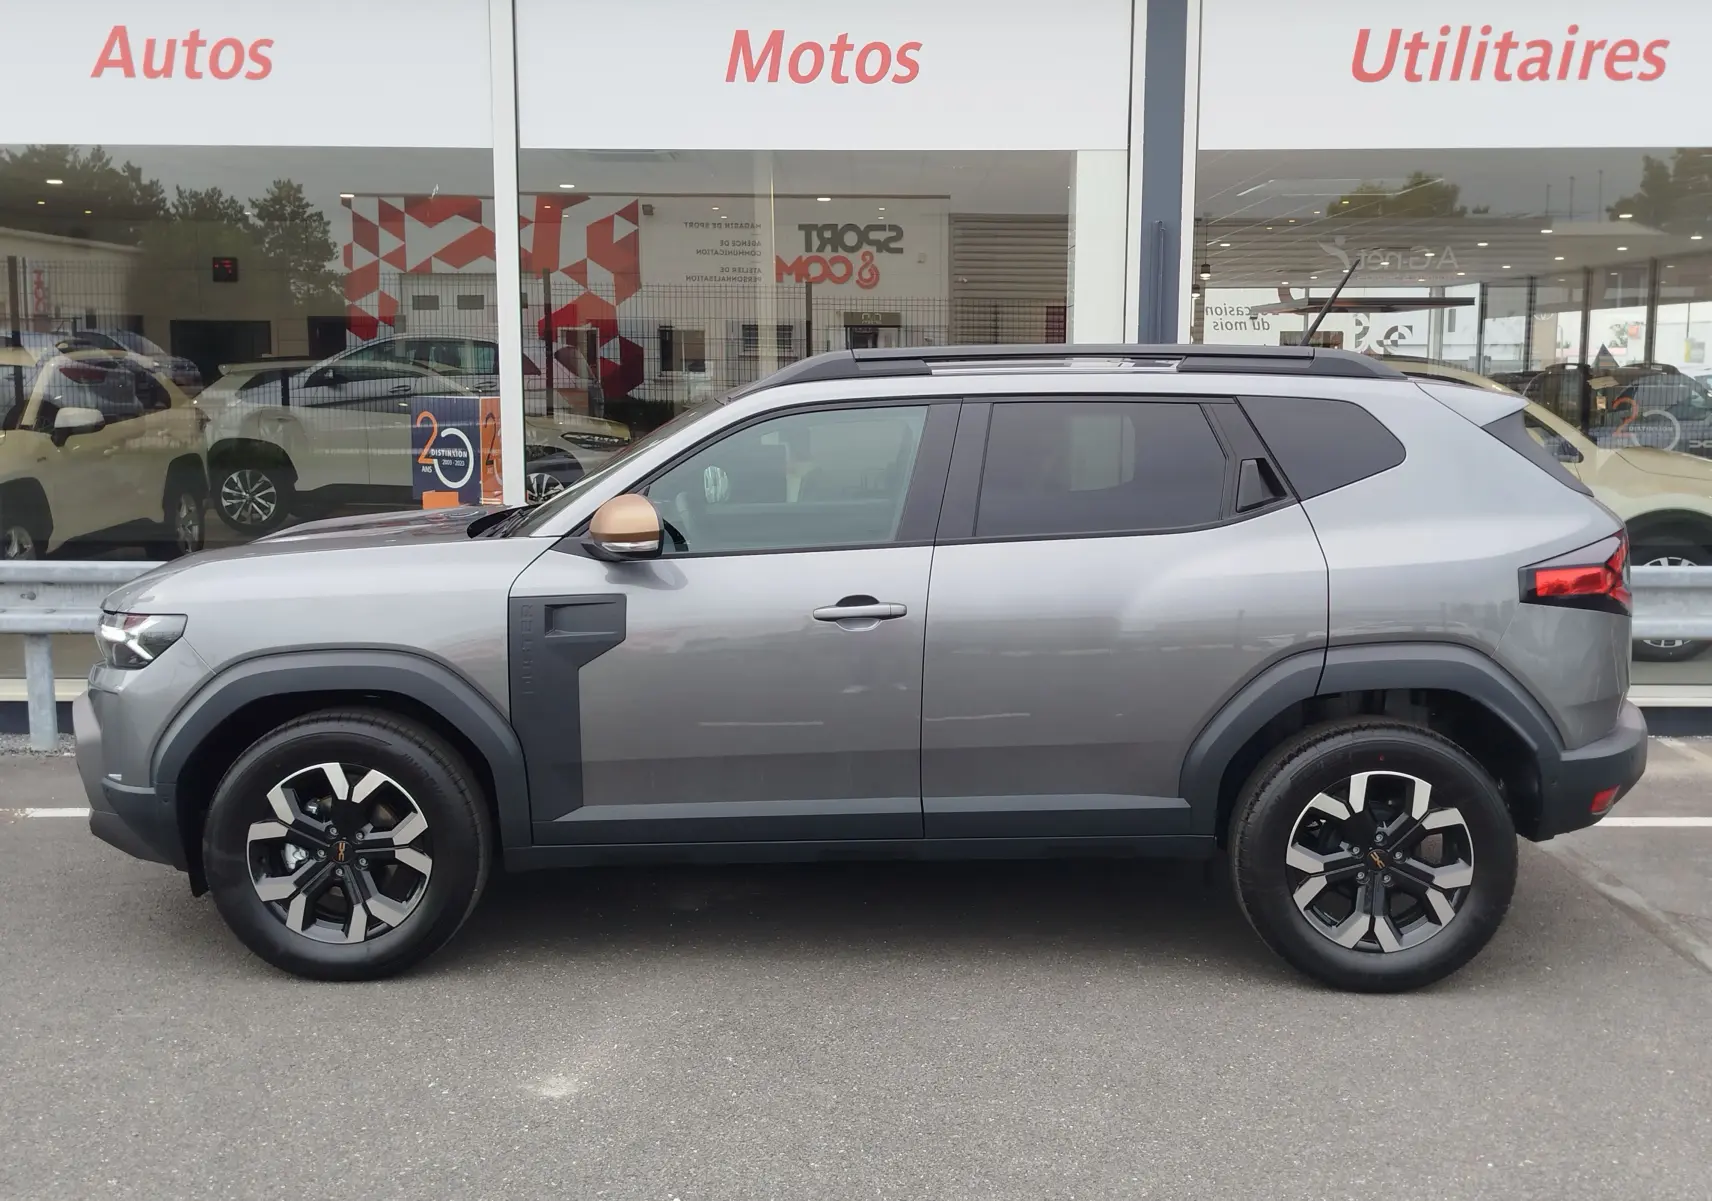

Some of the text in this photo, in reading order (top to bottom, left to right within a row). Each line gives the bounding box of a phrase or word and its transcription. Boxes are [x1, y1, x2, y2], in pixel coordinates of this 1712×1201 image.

[91, 25, 275, 81] Autos
[726, 29, 922, 84] Motos
[1351, 25, 1670, 83] Utilitaires
[421, 465, 433, 474] ANS
